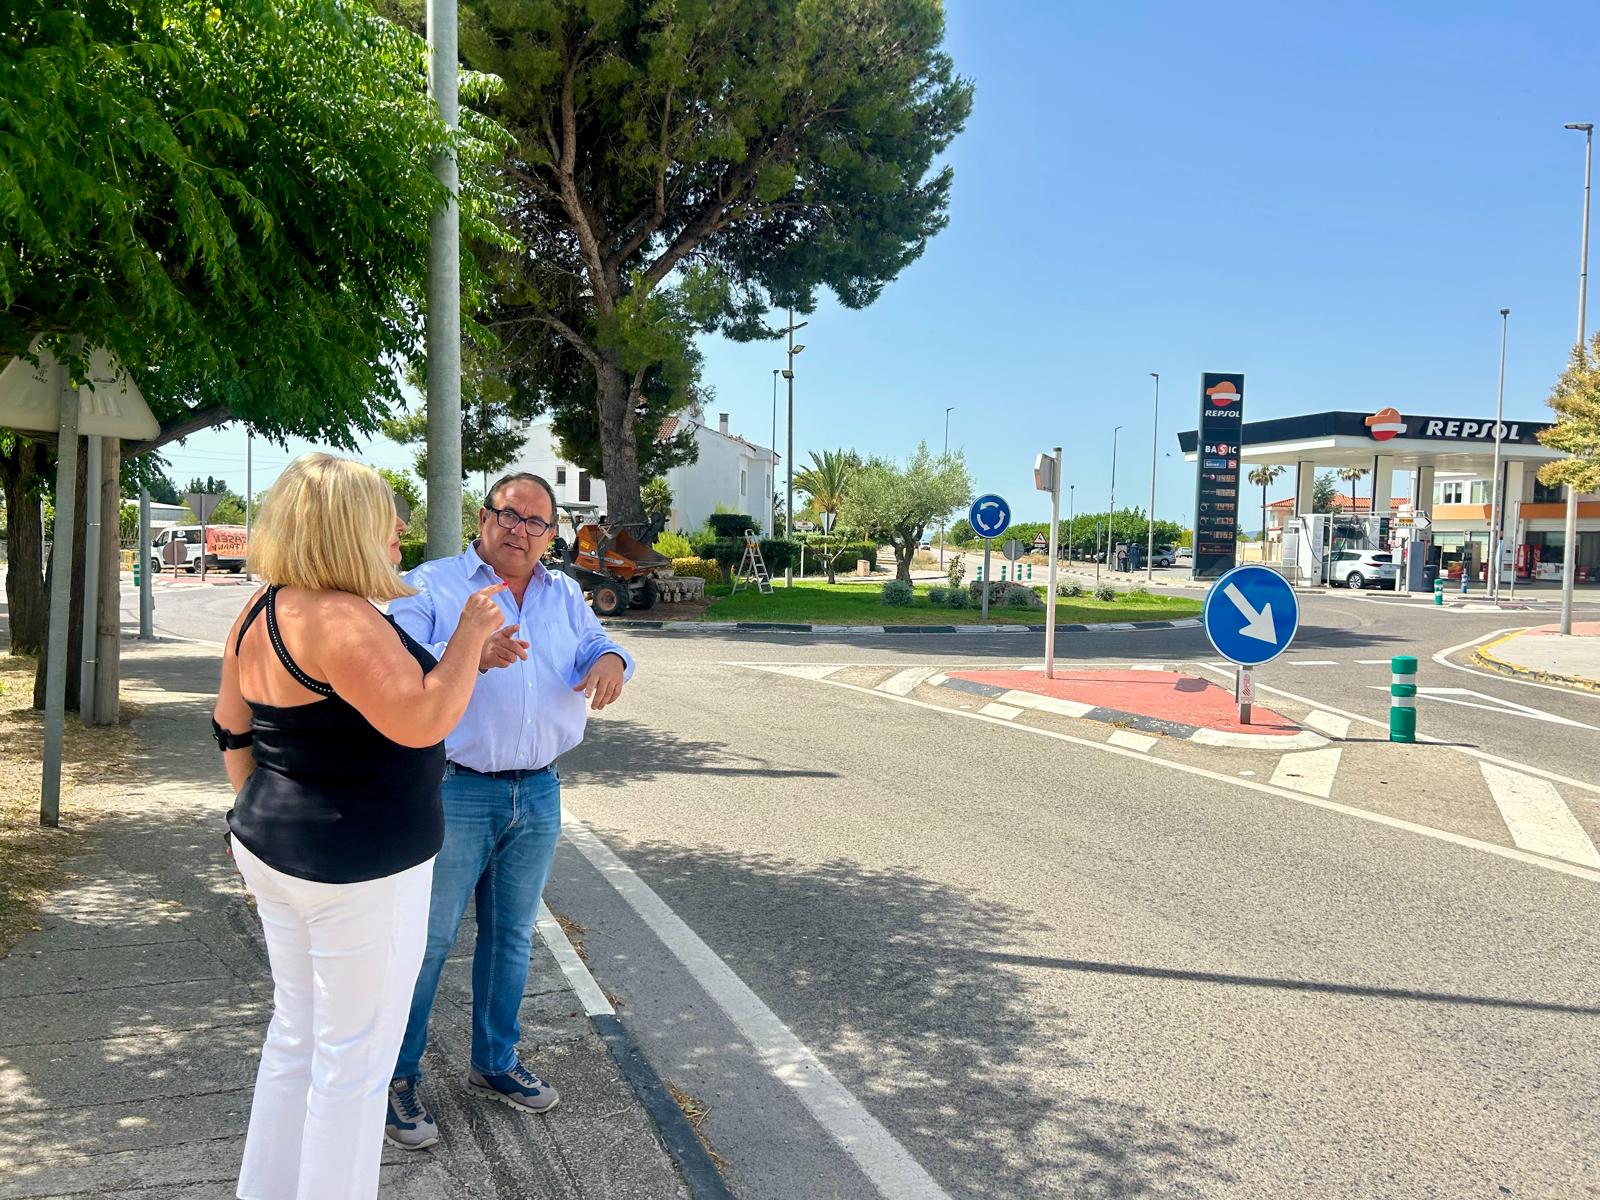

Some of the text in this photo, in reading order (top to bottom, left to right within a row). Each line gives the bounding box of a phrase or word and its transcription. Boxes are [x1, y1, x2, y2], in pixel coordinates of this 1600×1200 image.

[1205, 410, 1240, 418] REPSOL
[1426, 420, 1520, 440] REPSOL
[1205, 443, 1237, 456] BASIC
